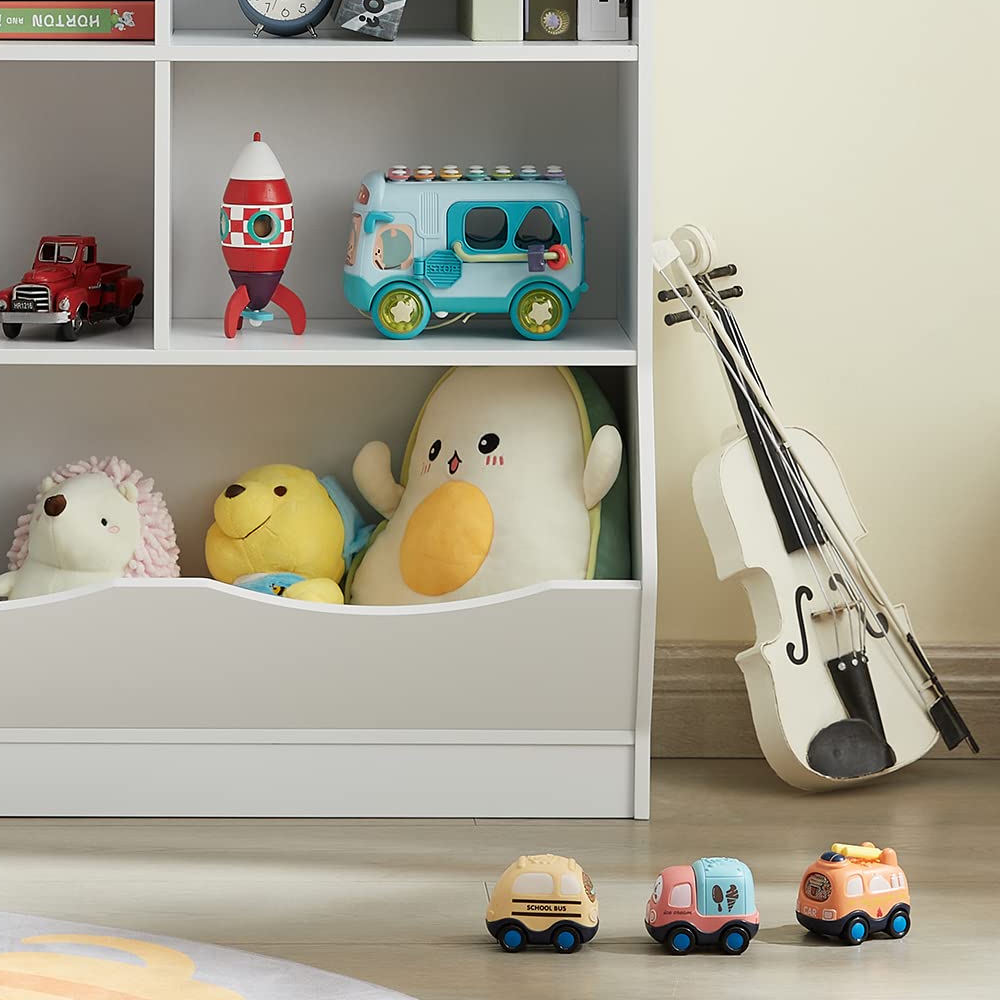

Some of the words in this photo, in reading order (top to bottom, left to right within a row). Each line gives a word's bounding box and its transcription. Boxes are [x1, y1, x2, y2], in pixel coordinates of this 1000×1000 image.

[265, 2, 271, 13] 7
[281, 7, 290, 18] 6
[298, 3, 307, 14] 5
[6, 16, 24, 25] AND
[32, 13, 100, 28] HORTON
[429, 264, 458, 273] STOP
[526, 904, 553, 912] SCHOOL
[802, 905, 818, 917] CAR
